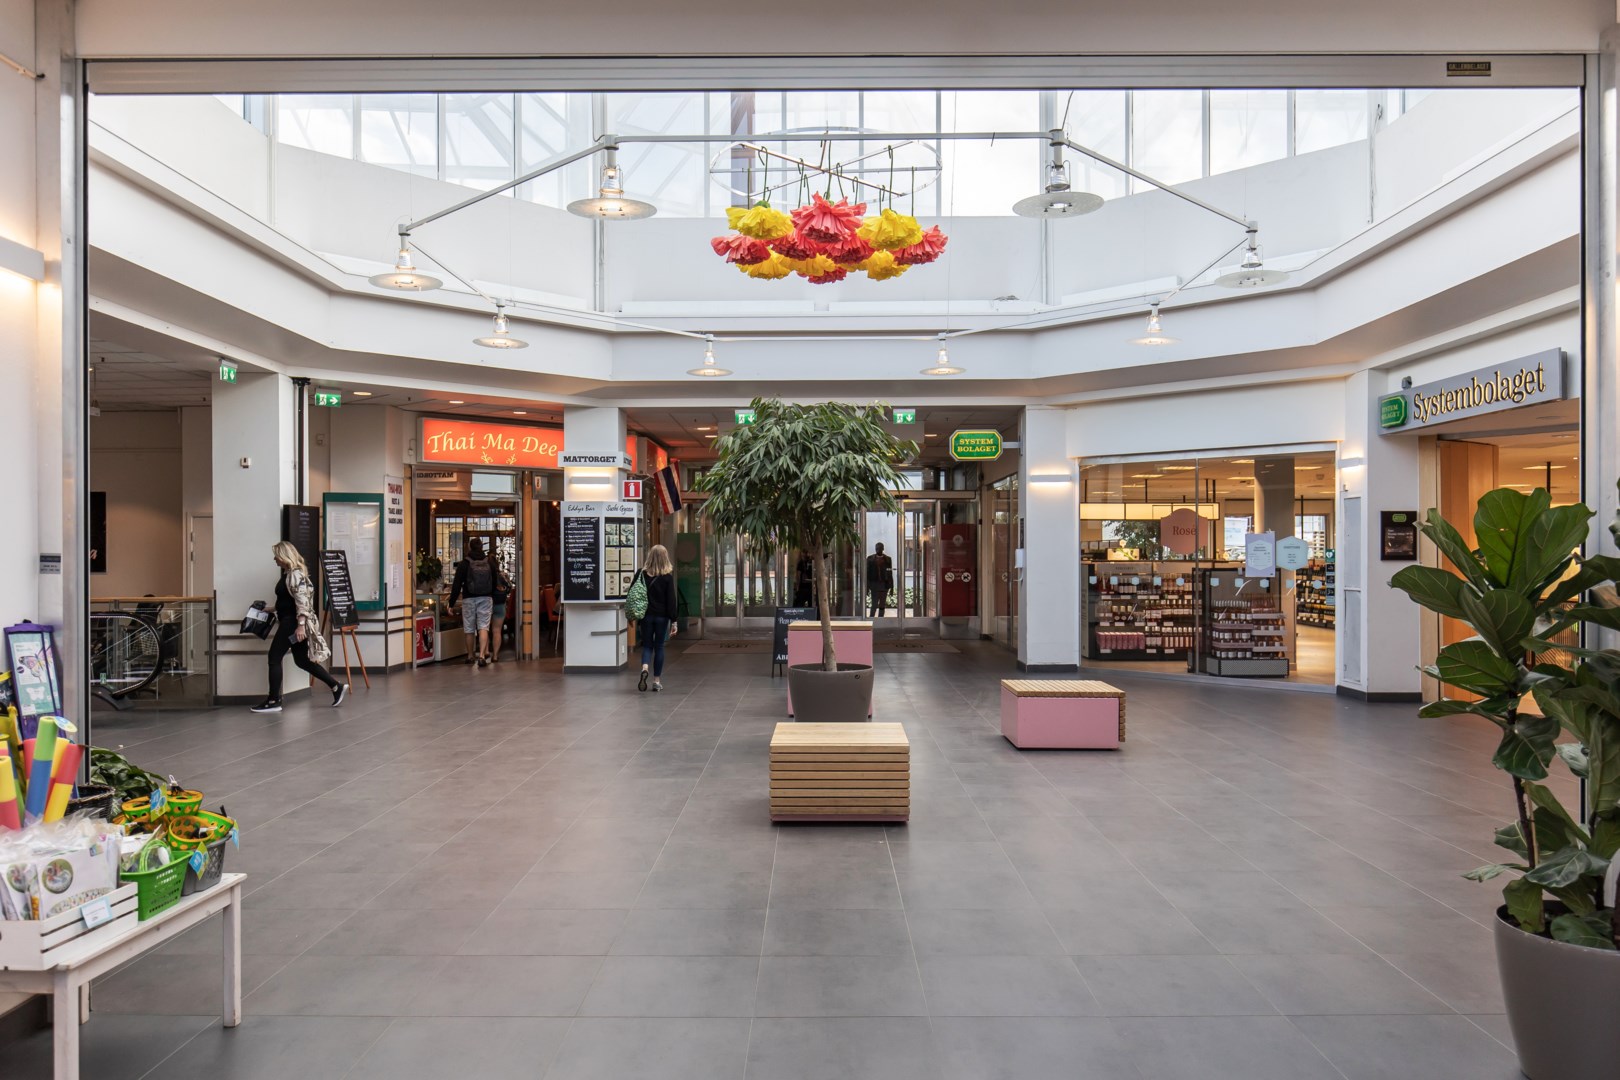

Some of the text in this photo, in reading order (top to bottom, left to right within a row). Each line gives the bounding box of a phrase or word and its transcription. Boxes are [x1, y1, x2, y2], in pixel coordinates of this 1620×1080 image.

[1413, 362, 1546, 422] Systembolaget
[427, 431, 557, 457] Thai Ma Dee
[957, 445, 997, 453] BOLAGET
[1172, 524, 1198, 536] Rosé
